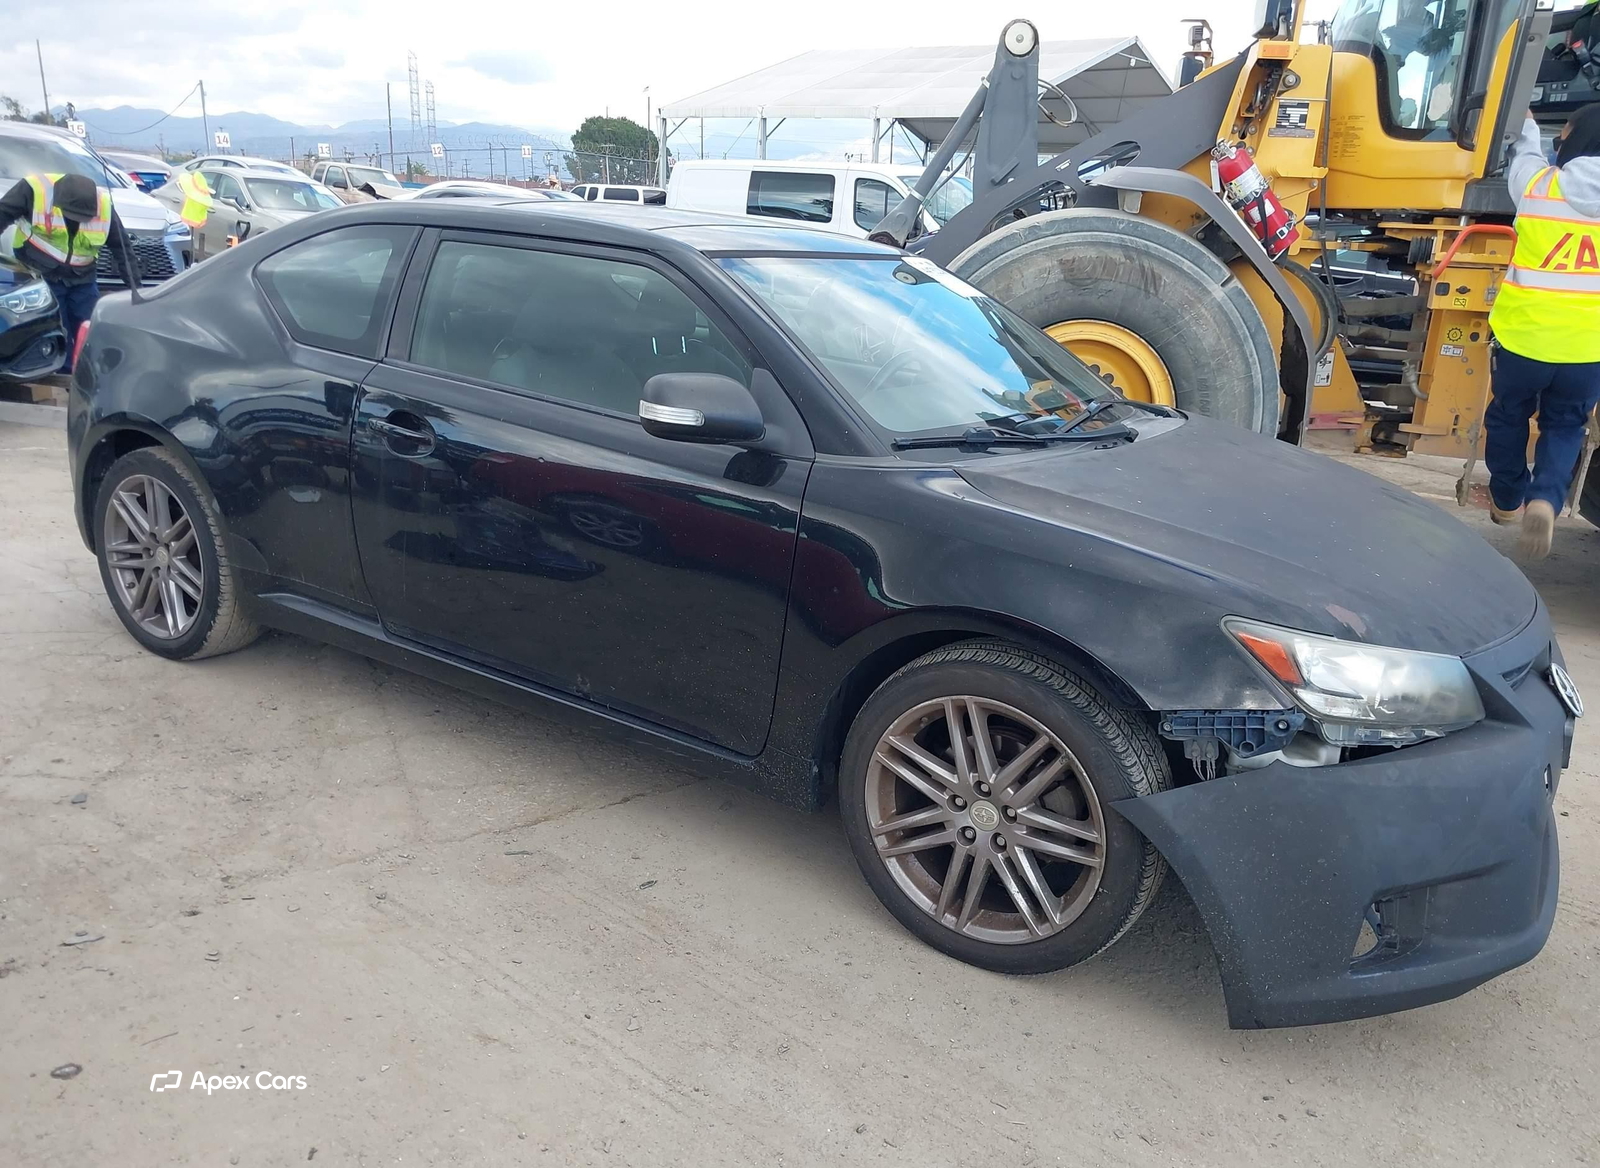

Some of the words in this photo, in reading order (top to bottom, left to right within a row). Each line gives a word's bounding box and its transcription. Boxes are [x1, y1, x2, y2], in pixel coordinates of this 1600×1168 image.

[70, 124, 84, 135] 15
[216, 135, 229, 145] 14
[319, 146, 330, 155] 13
[432, 146, 443, 155] 12
[522, 147, 531, 156] 11
